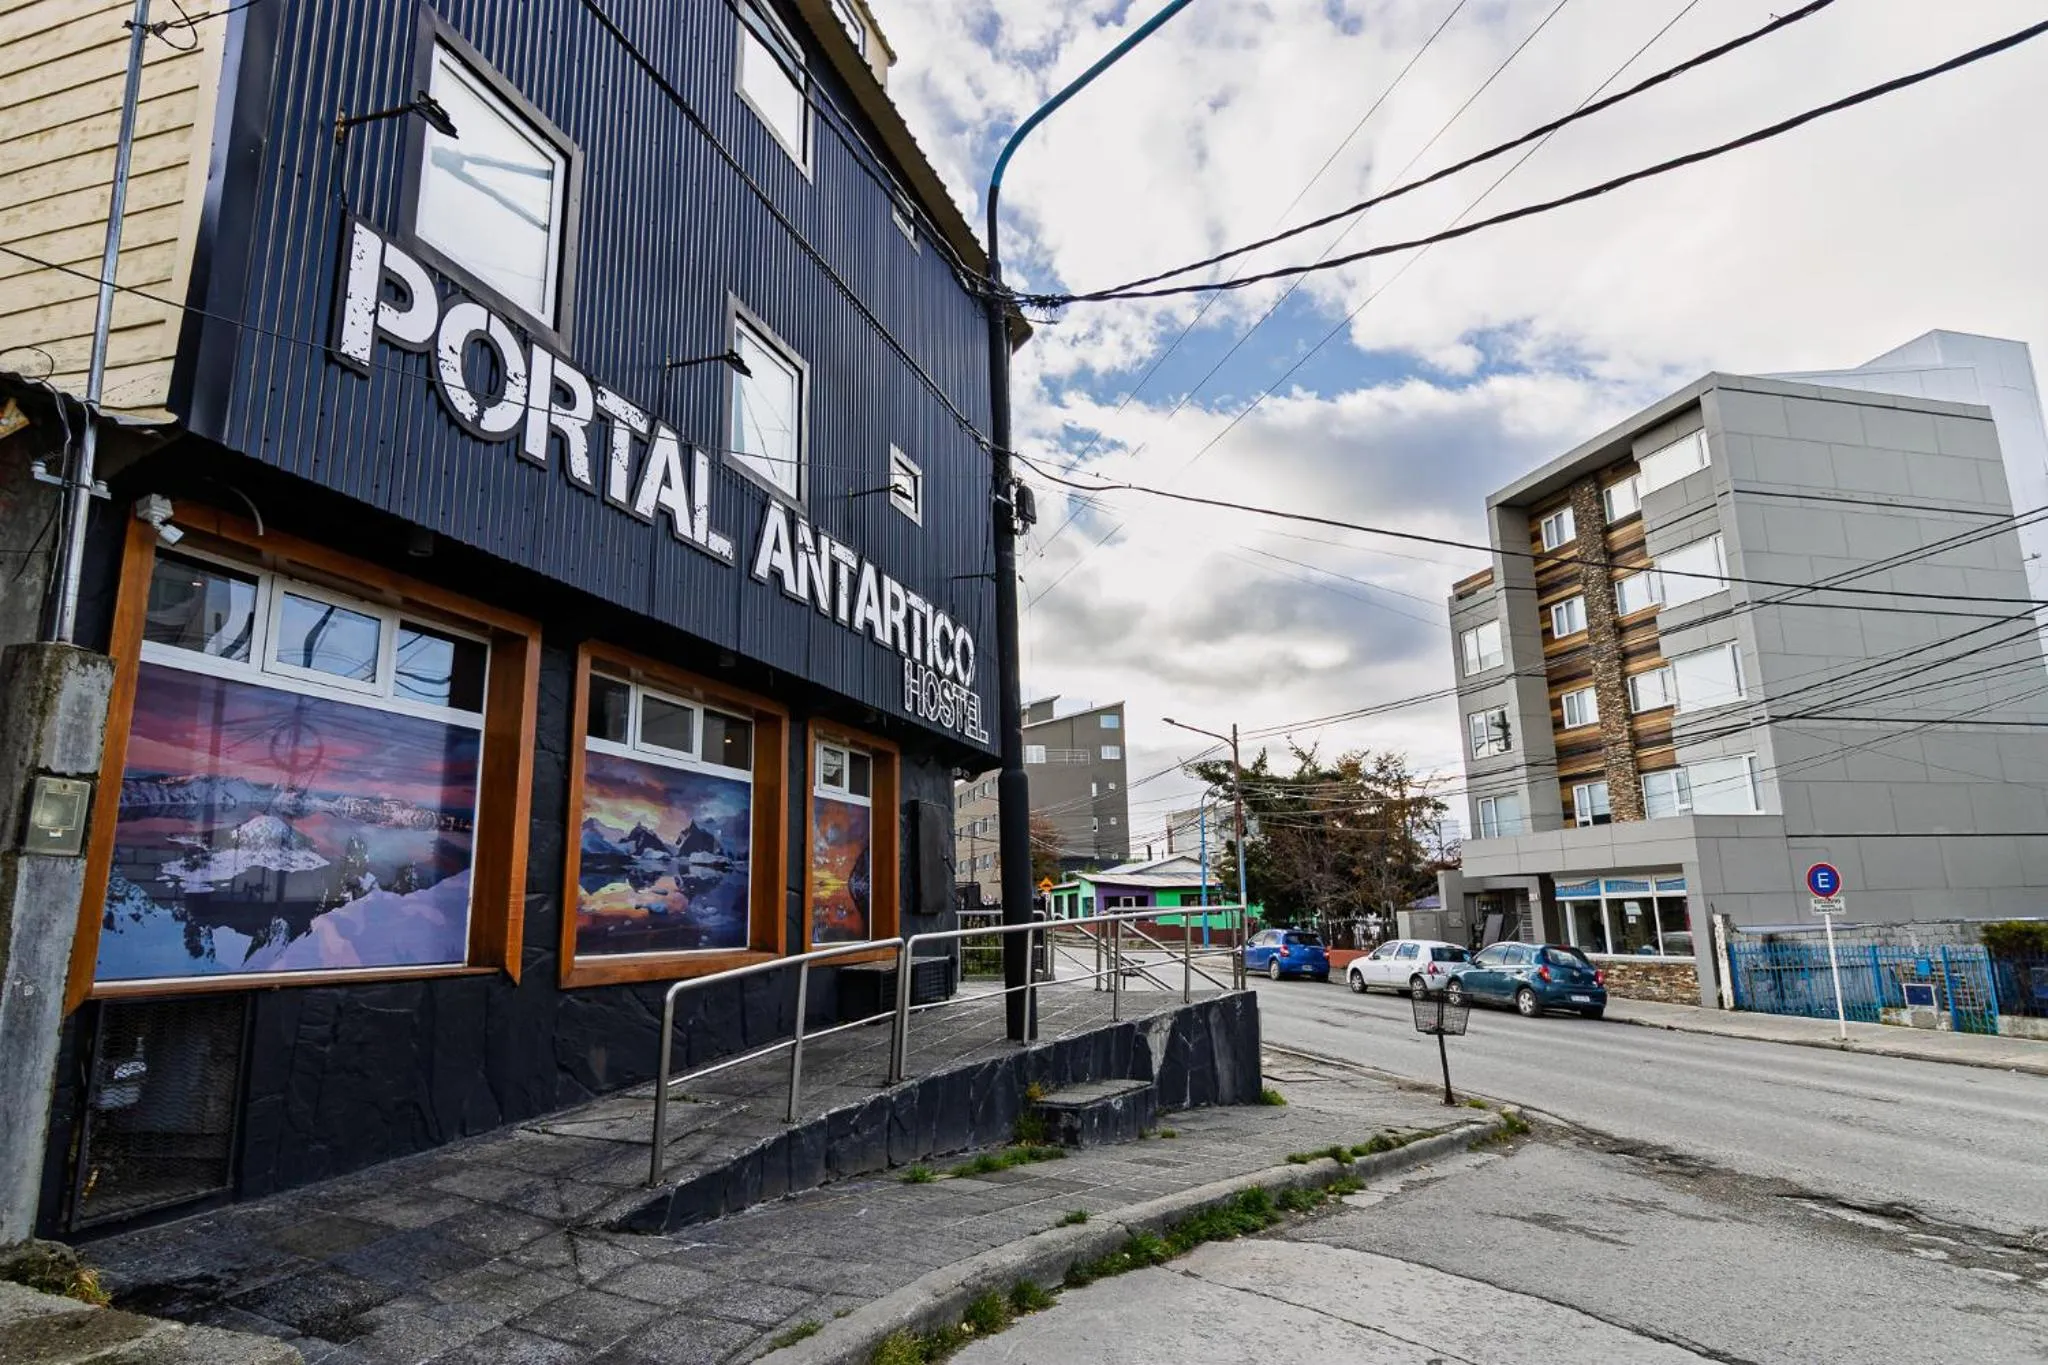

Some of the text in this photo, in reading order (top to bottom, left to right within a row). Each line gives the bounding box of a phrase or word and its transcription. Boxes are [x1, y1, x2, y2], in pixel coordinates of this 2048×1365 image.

[340, 221, 976, 687] PORTAL ANTARTICO
[904, 659, 989, 744] HOSTEL
[1817, 872, 1831, 888] E
